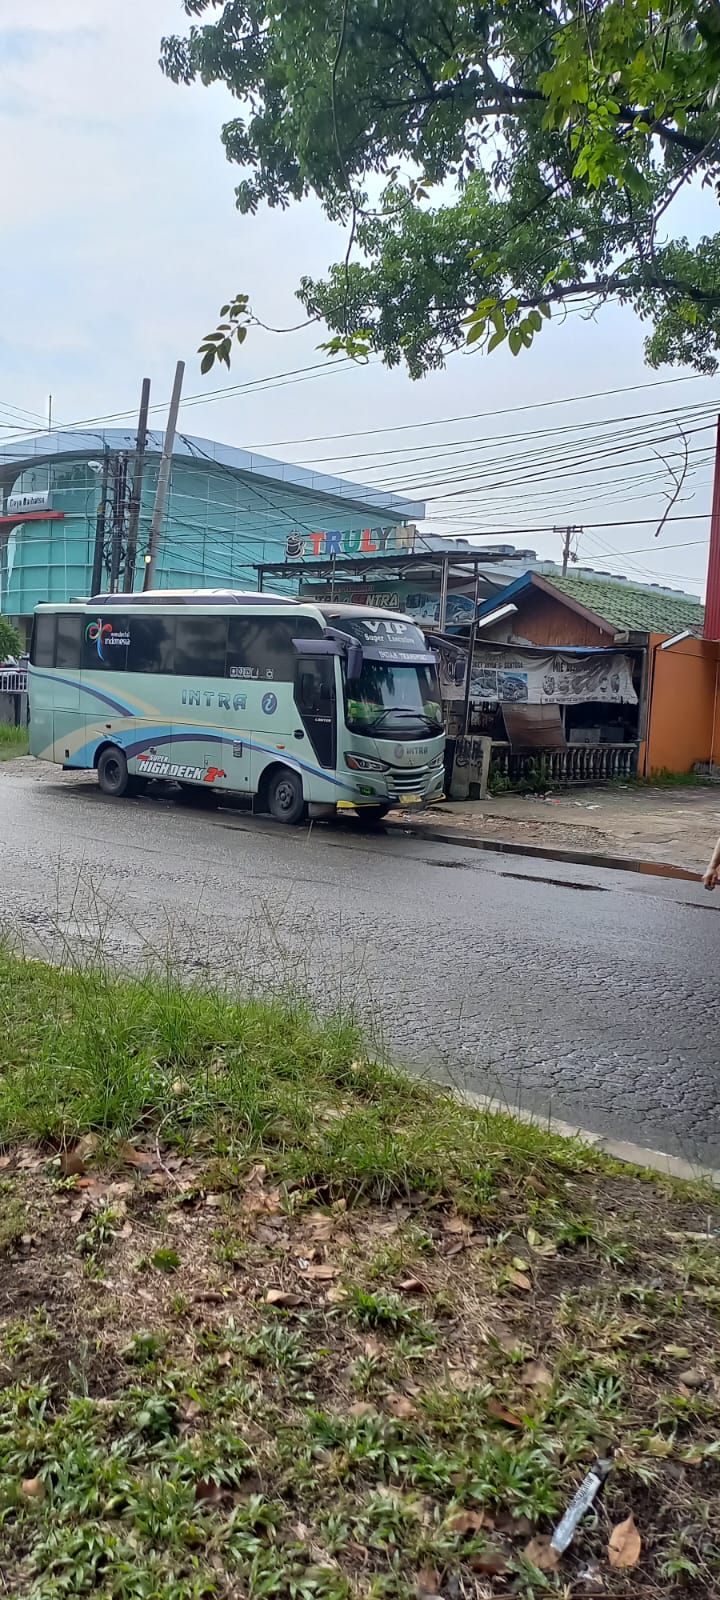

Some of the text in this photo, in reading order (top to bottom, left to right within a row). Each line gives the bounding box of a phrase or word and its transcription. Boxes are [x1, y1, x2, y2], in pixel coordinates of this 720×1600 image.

[361, 620, 407, 634] VIP
[364, 633, 385, 642] Super
[181, 689, 248, 711] INTRA
[138, 760, 169, 774] HIGH
[168, 762, 204, 780] DECK
